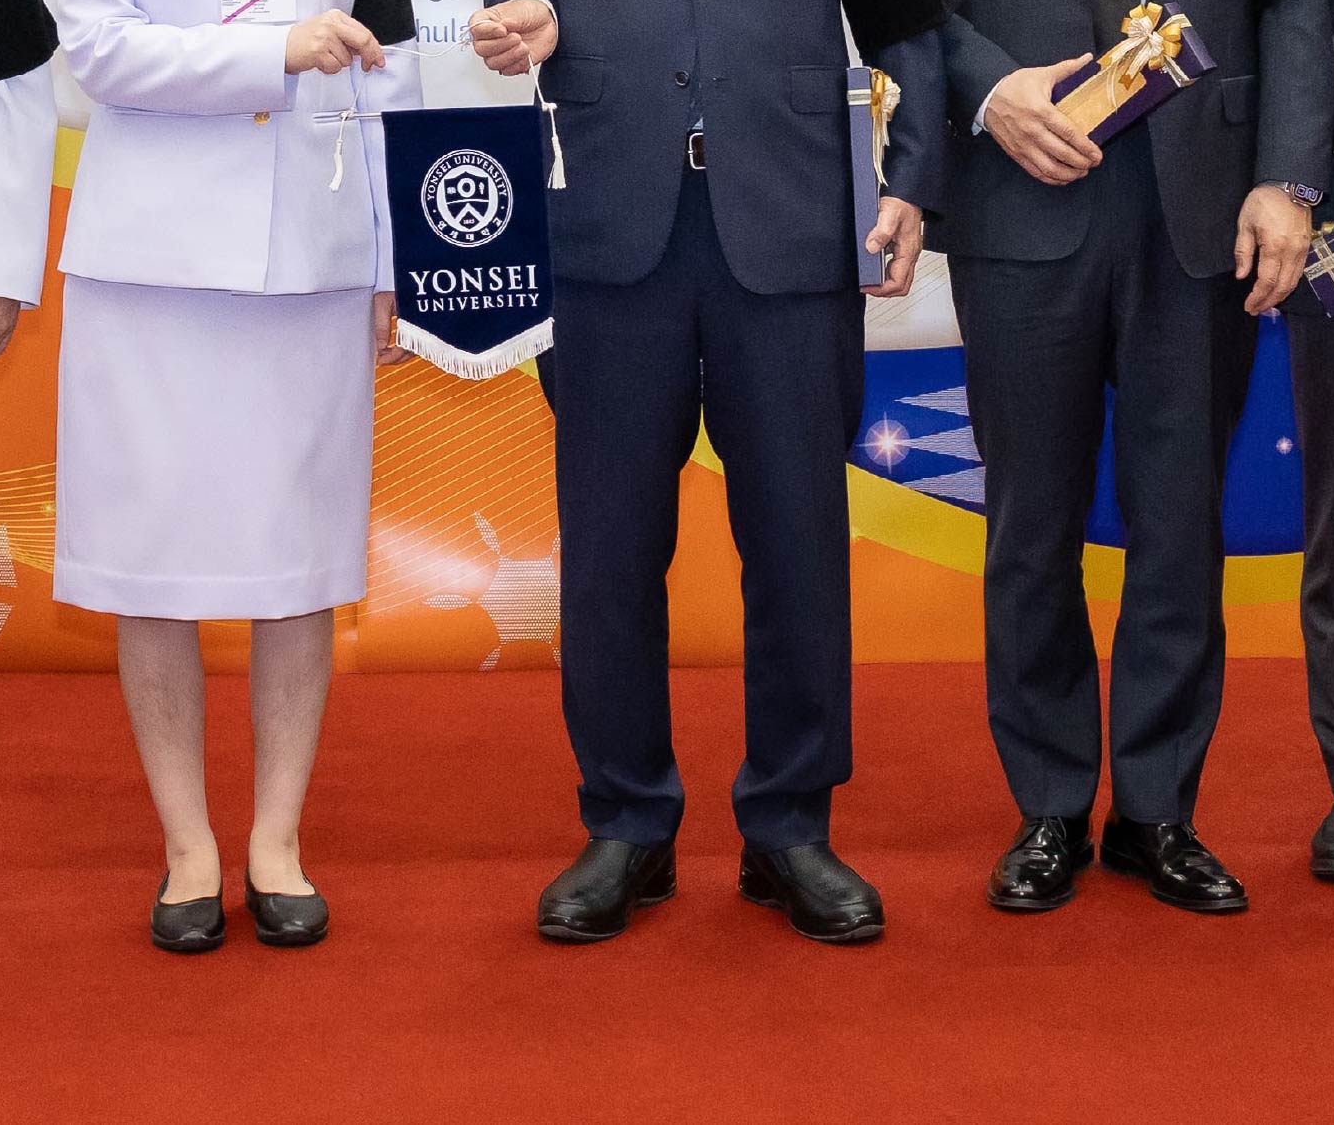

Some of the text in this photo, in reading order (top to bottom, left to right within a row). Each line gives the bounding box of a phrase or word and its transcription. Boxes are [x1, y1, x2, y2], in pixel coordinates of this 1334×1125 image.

[426, 154, 508, 202] YONSEI UNIVERSITY
[408, 264, 539, 296] YONSEI
[417, 293, 540, 313] UNIVERSITY
